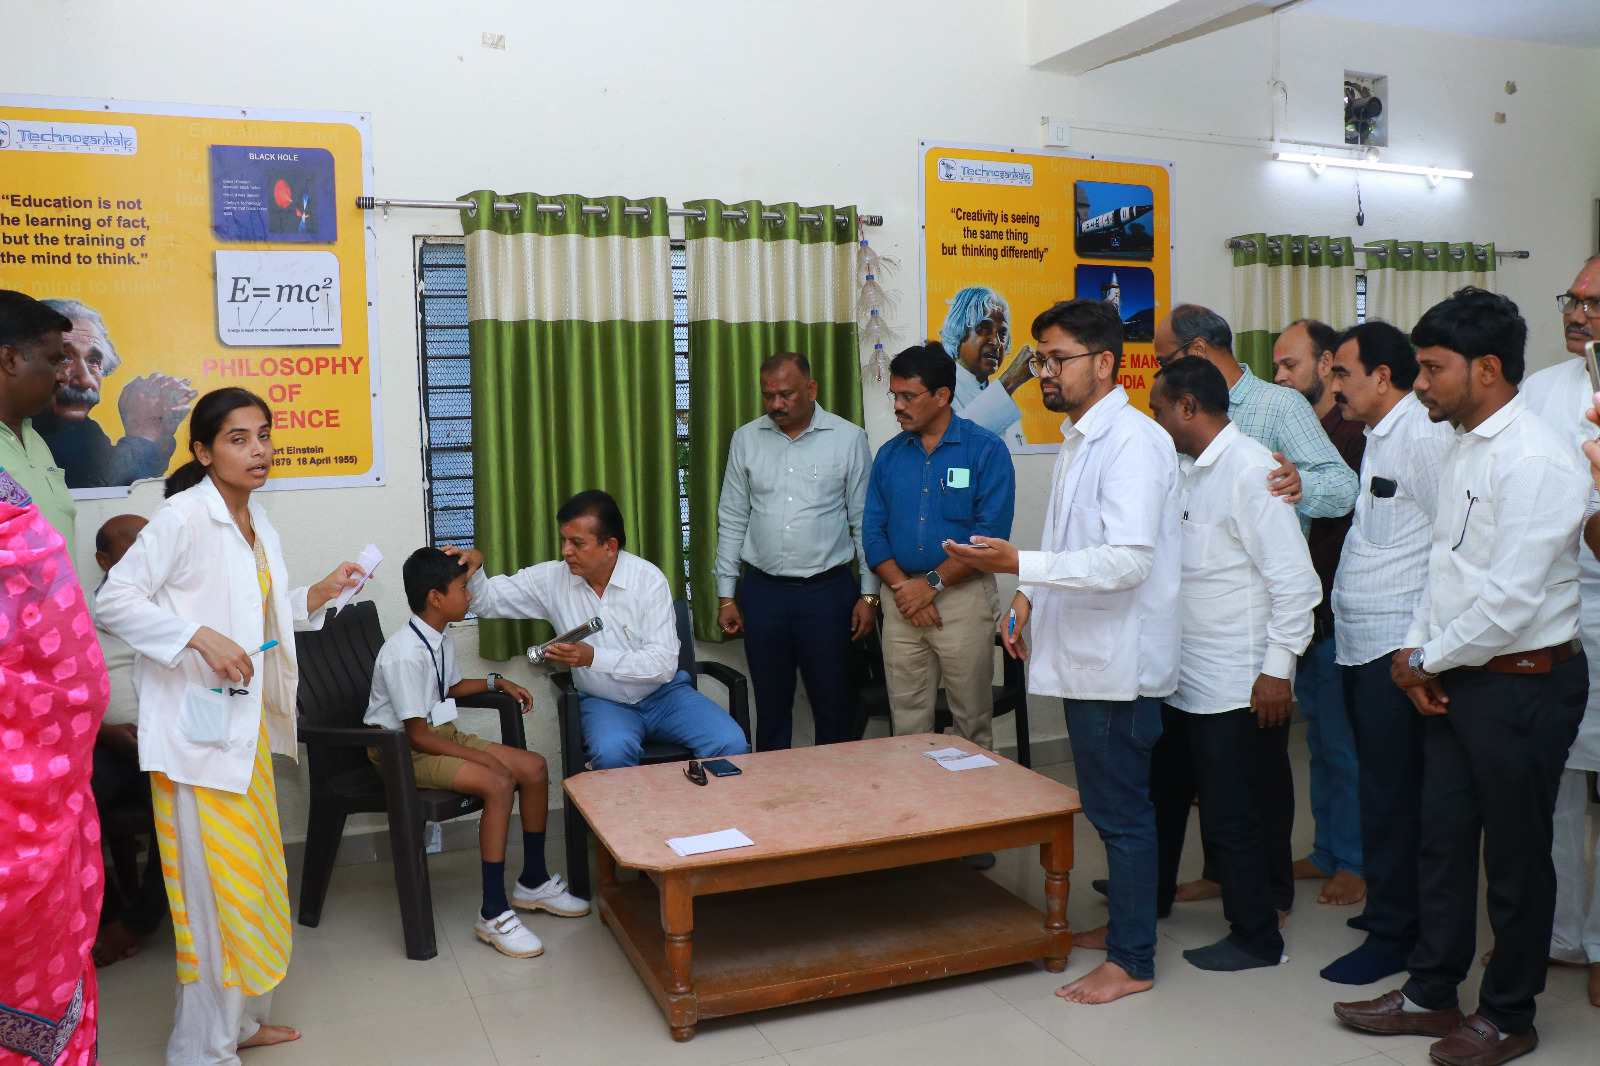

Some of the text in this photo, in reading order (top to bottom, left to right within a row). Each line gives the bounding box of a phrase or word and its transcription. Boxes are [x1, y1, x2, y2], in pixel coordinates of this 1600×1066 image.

[17, 127, 133, 150] Technosankalp
[249, 153, 299, 162] BLACK HOLE
[1, 194, 142, 210] “Education is not
[25, 214, 92, 230] learning
[96, 216, 113, 228] of
[116, 216, 150, 231] fact,
[951, 208, 1040, 227] “Creativity is seeing
[2, 232, 146, 249] but the training of
[963, 226, 1028, 244] the same thing
[0, 252, 148, 265] the mind to think.”
[942, 243, 1048, 263] but thinking differently”
[203, 356, 363, 377] PHILOSOPHY
[1131, 354, 1159, 368] MAN
[268, 384, 302, 403] OF
[272, 409, 340, 429] ENCE
[287, 446, 324, 454] Einstein
[309, 456, 331, 466] April
[334, 455, 358, 465] 1955)
